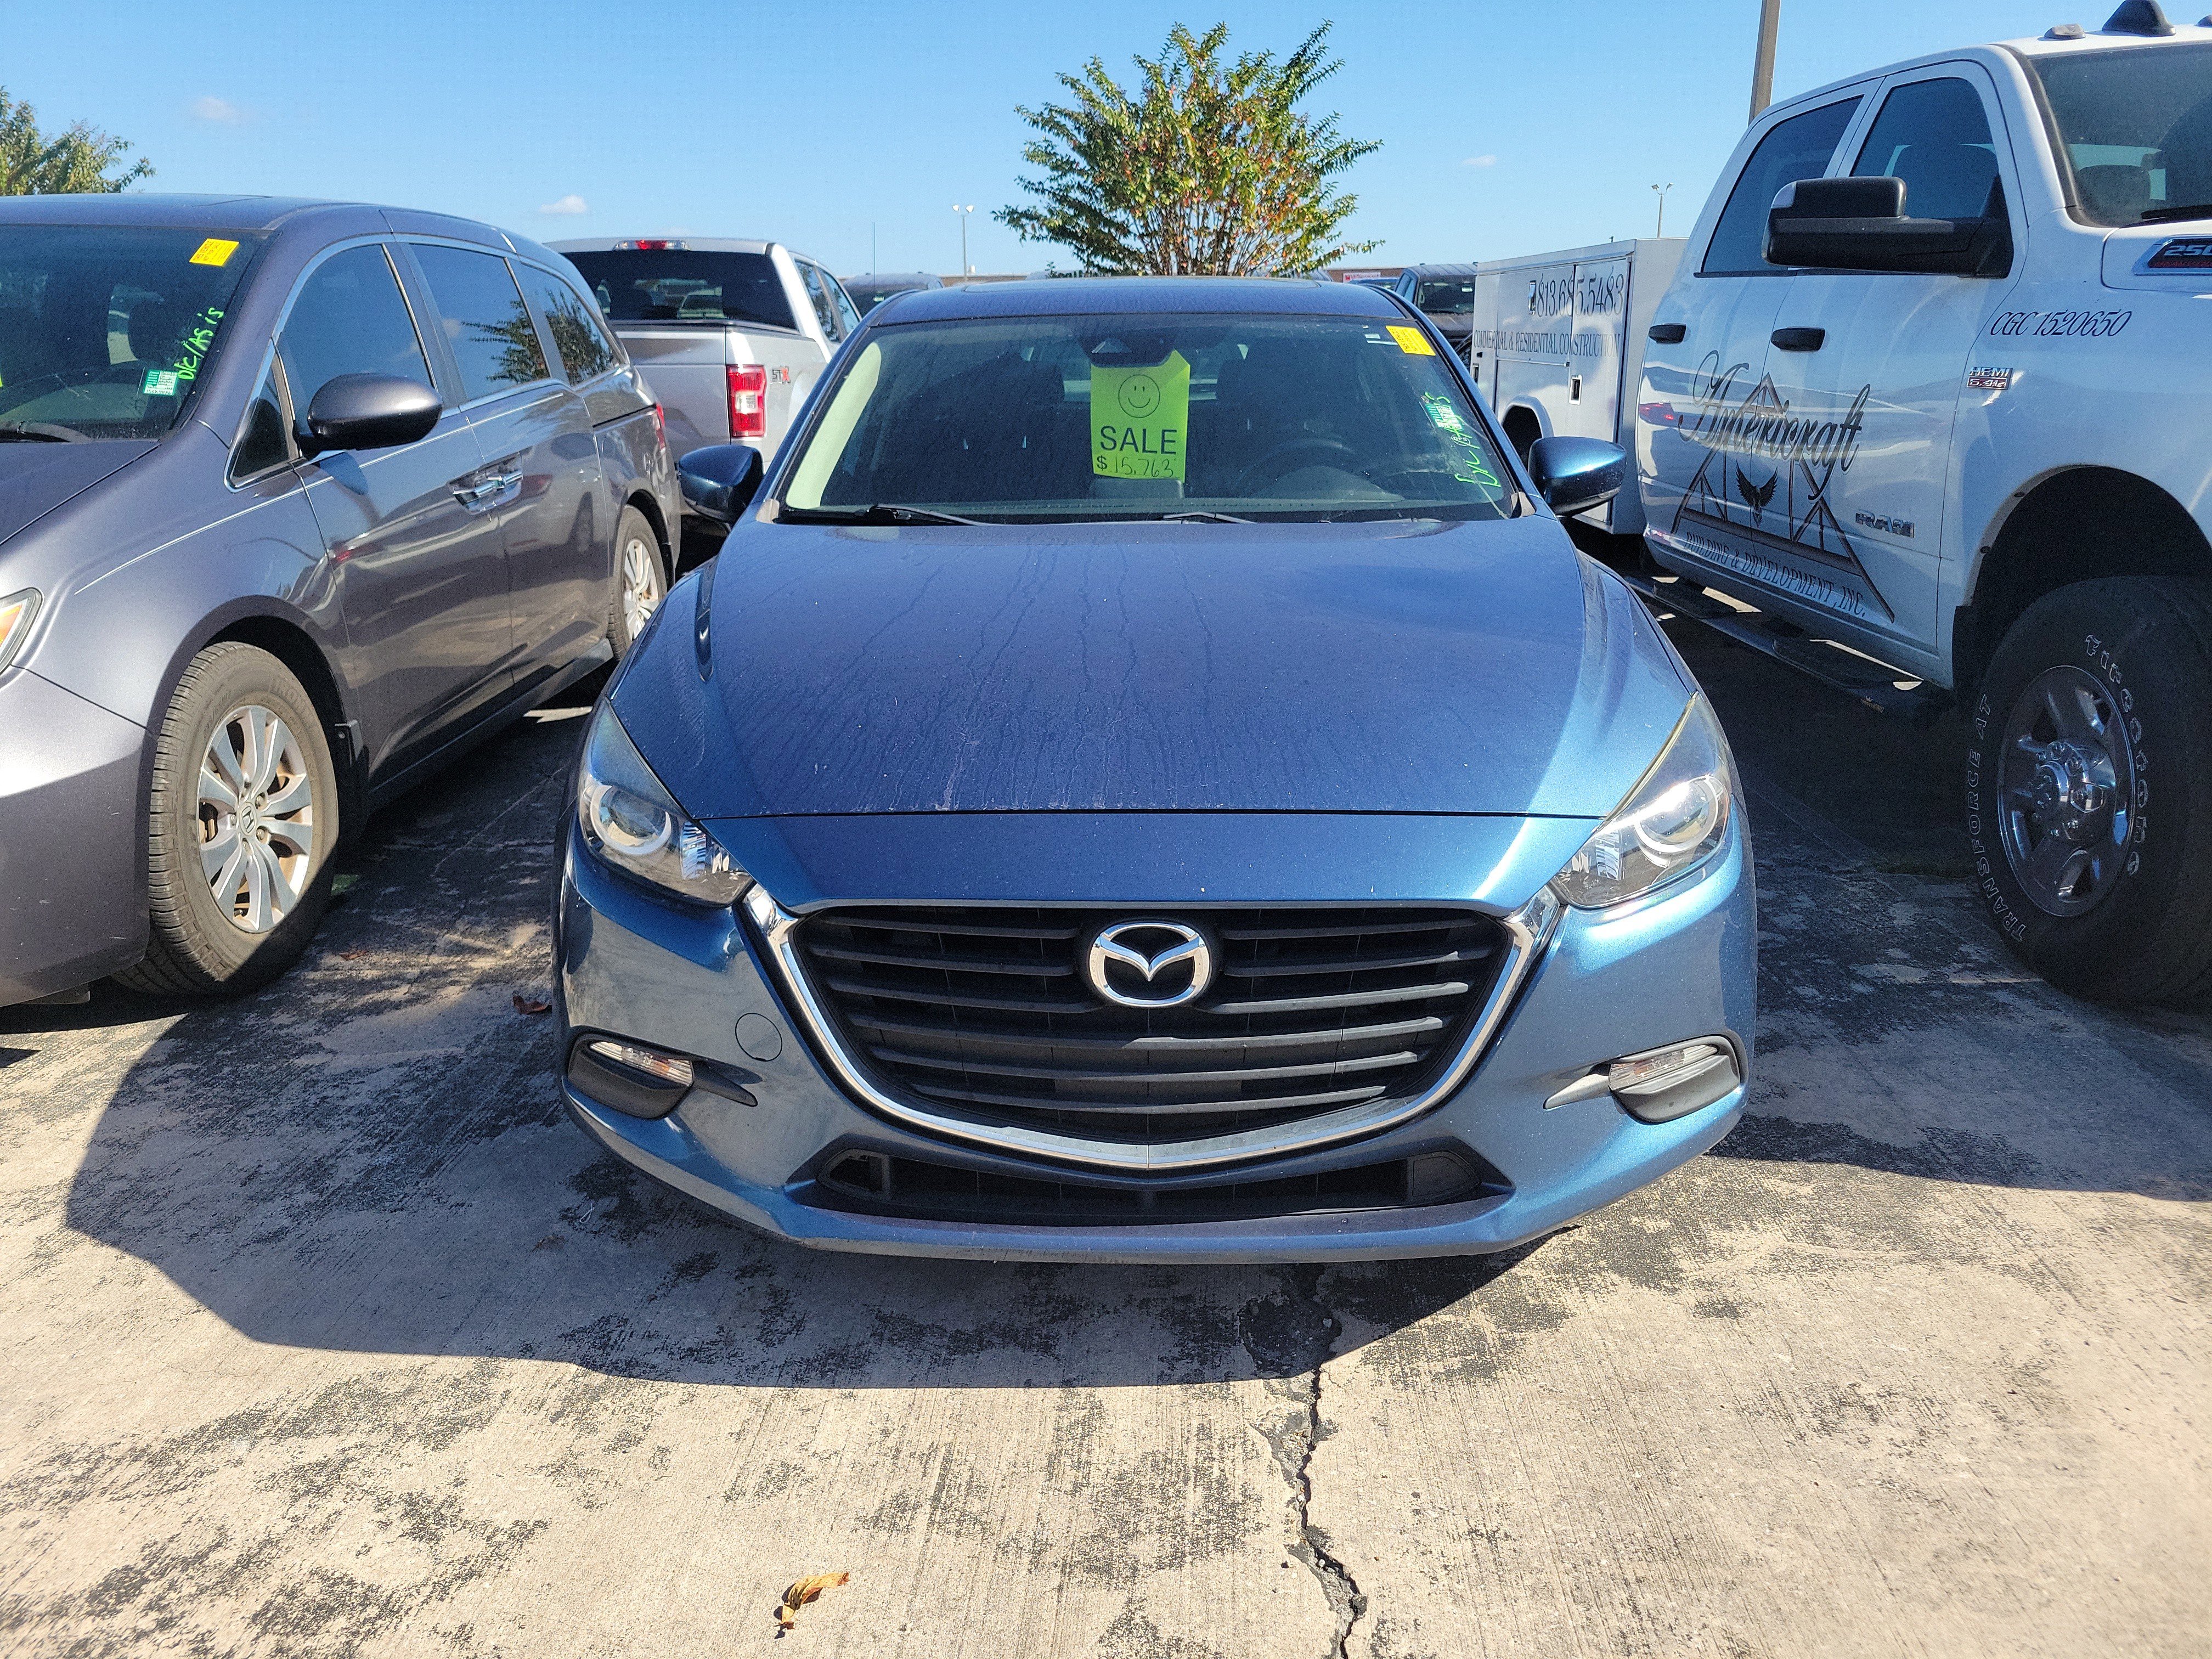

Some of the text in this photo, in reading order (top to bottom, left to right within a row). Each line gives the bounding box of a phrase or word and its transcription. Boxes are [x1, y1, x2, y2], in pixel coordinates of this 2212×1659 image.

[1537, 266, 1624, 318] 813.685.5483
[1990, 309, 2132, 337] CGC 1520650
[1509, 331, 1514, 351] &
[1516, 332, 1558, 354] RESIDENTIAL
[771, 366, 791, 383] STX
[1968, 366, 2011, 377] HEMI
[1100, 426, 1177, 455] SALE
[1855, 509, 1915, 539] RAM
[1685, 532, 1730, 565] BUILDING
[1731, 550, 1740, 569] &
[1741, 552, 1835, 603] DEVELOPMENT
[1967, 693, 2028, 942] TRANSFORCE AT
